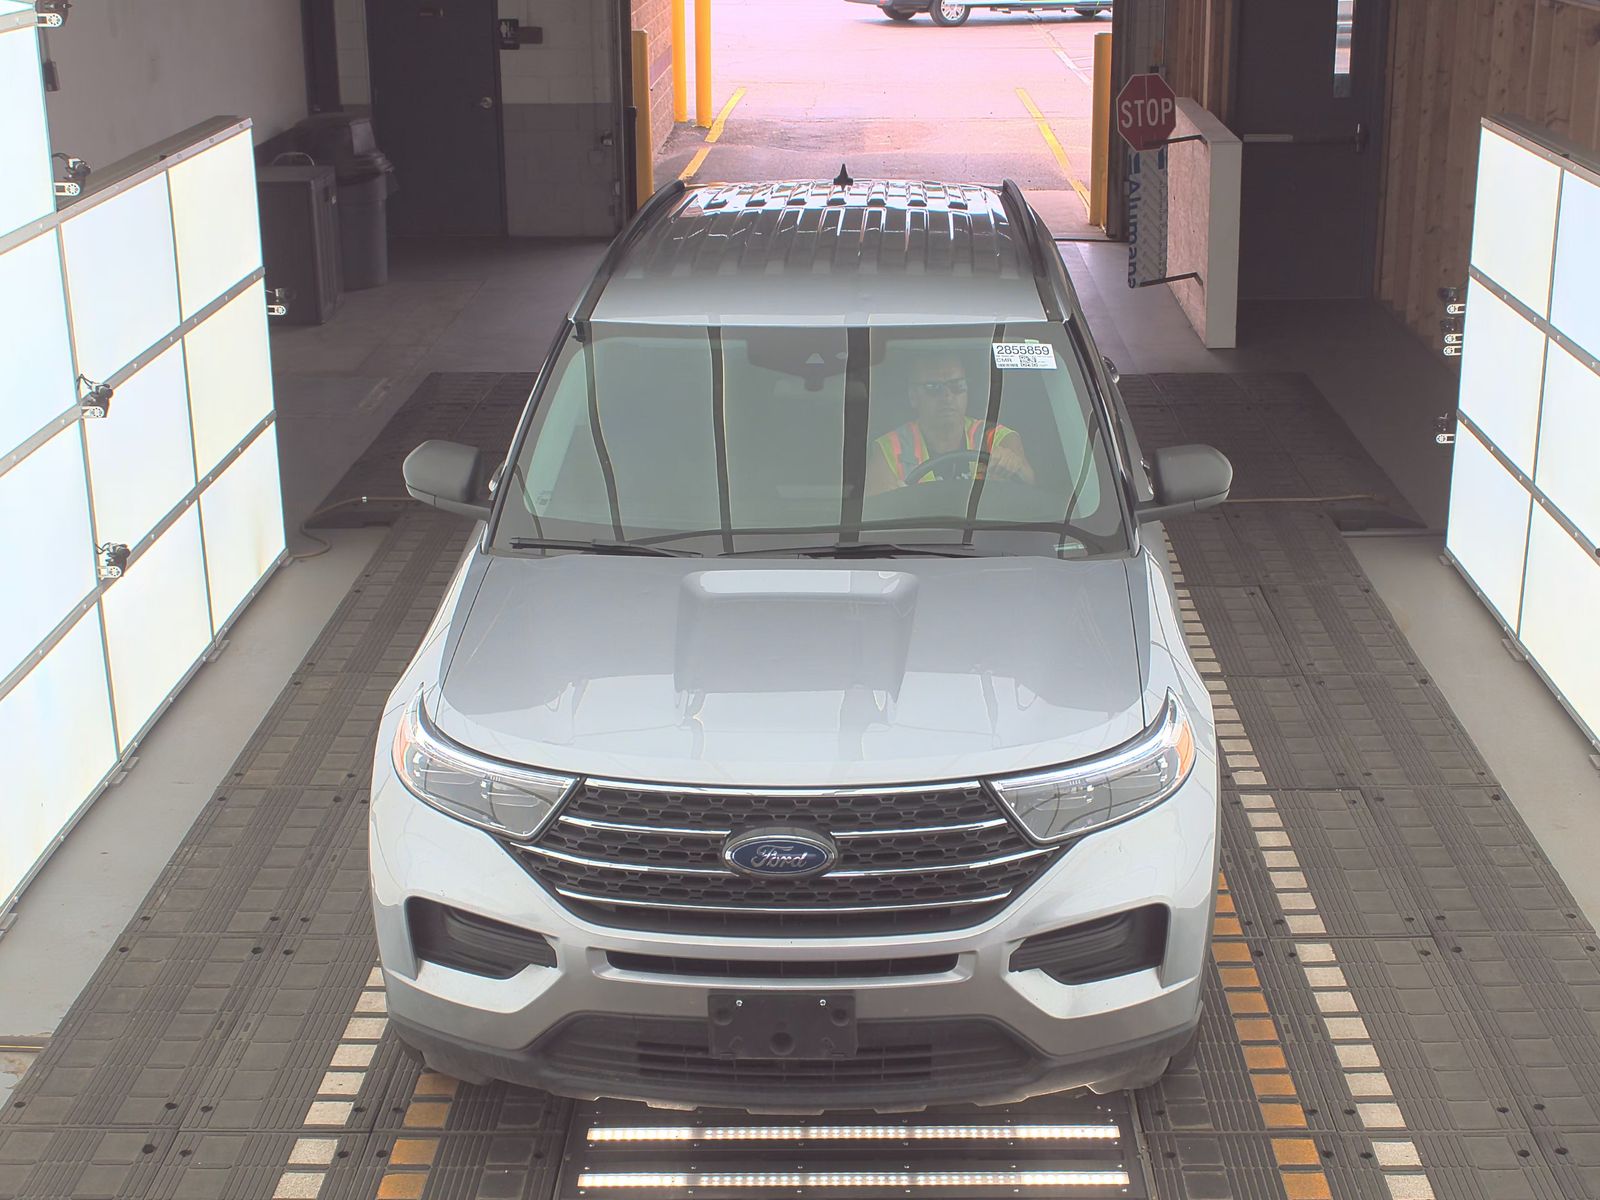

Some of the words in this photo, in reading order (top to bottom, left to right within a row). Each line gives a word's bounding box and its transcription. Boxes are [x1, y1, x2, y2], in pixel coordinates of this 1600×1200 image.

[1121, 97, 1173, 128] STOP
[996, 345, 1050, 355] 2855859
[750, 844, 808, 868] Ford
